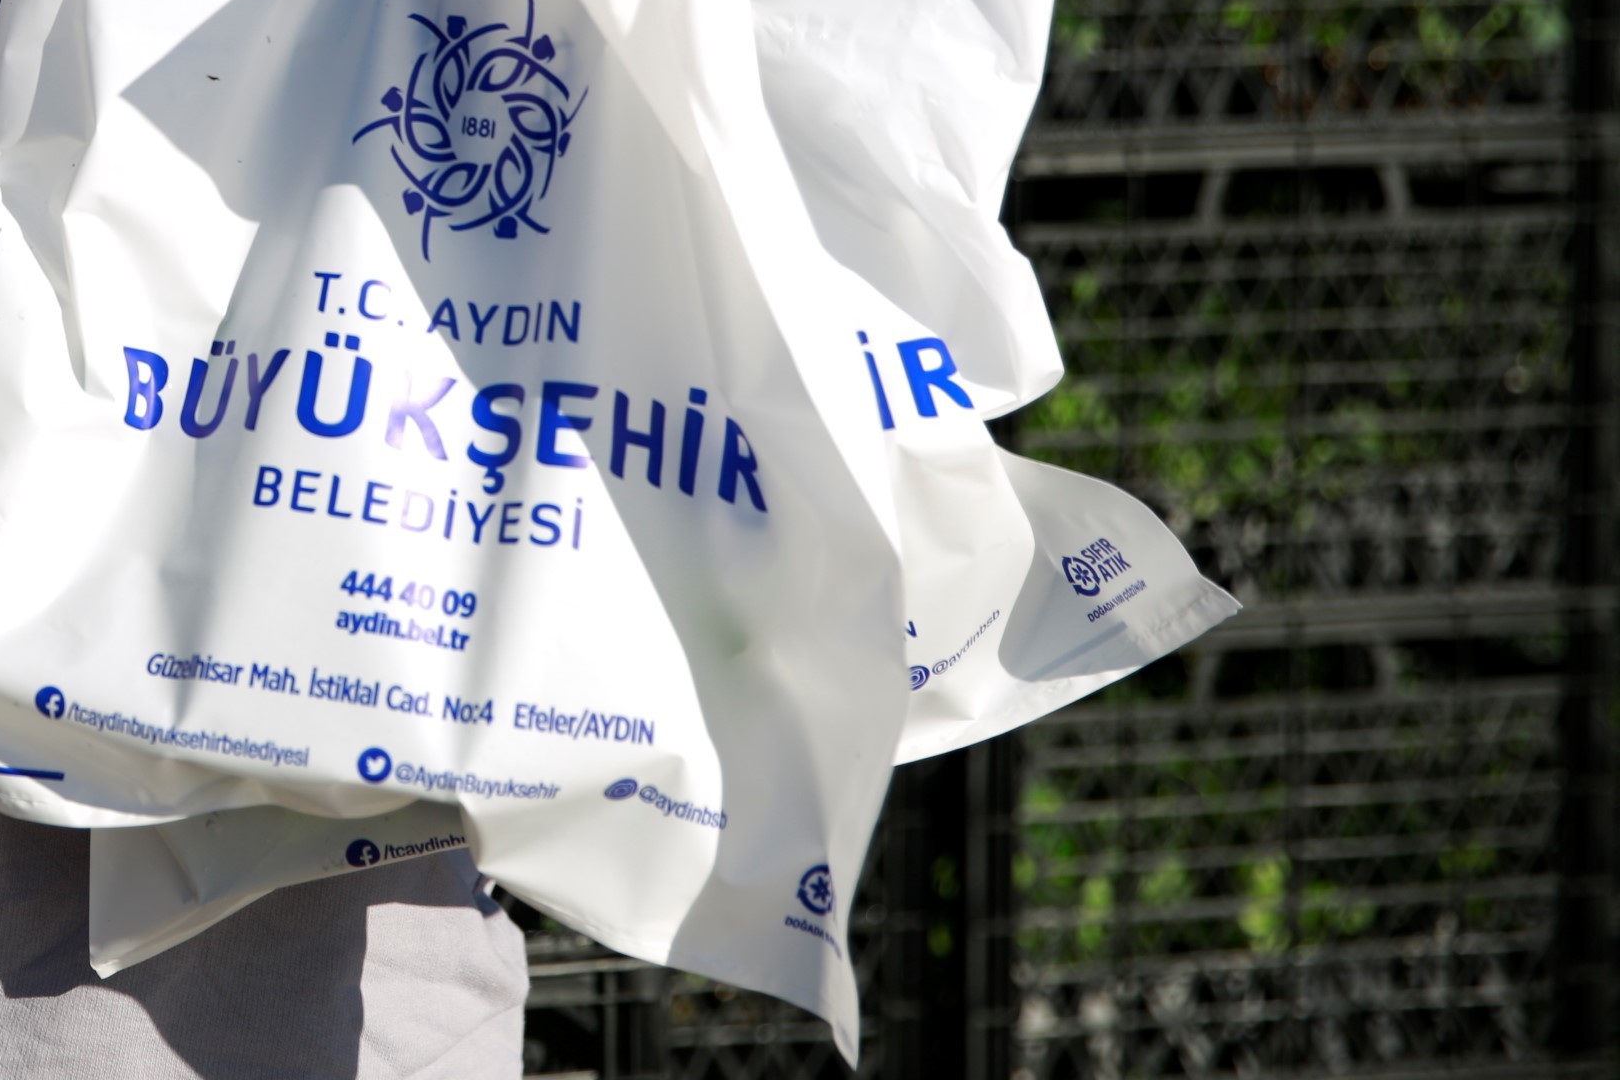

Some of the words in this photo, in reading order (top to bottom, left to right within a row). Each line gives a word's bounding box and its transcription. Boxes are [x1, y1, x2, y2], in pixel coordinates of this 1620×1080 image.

[461, 115, 497, 140] 1881
[426, 297, 580, 346] AYDIN
[123, 331, 769, 514] BÜYÜKŞEHİR
[252, 465, 584, 551] BELEDİYESİ
[1081, 538, 1118, 565] SIFIR
[1097, 551, 1131, 582] ATIK
[340, 570, 392, 602] 444
[399, 581, 436, 612] 40
[442, 589, 477, 619] 09
[336, 607, 470, 652] aydin.bel.tr
[932, 609, 1000, 675] @aydinbsb
[147, 653, 242, 687] Güzelhisar
[250, 668, 300, 696] Mah.
[309, 667, 379, 707] İstiklal
[386, 685, 434, 717] Cad.
[442, 697, 494, 724] No:4
[514, 703, 655, 745] Efeler/AYDIN
[68, 702, 310, 767] /tcaydinbuyuksehirbelediyesi
[395, 763, 561, 800] @AydinBuyuksehir
[638, 785, 728, 830] @aydinbsb
